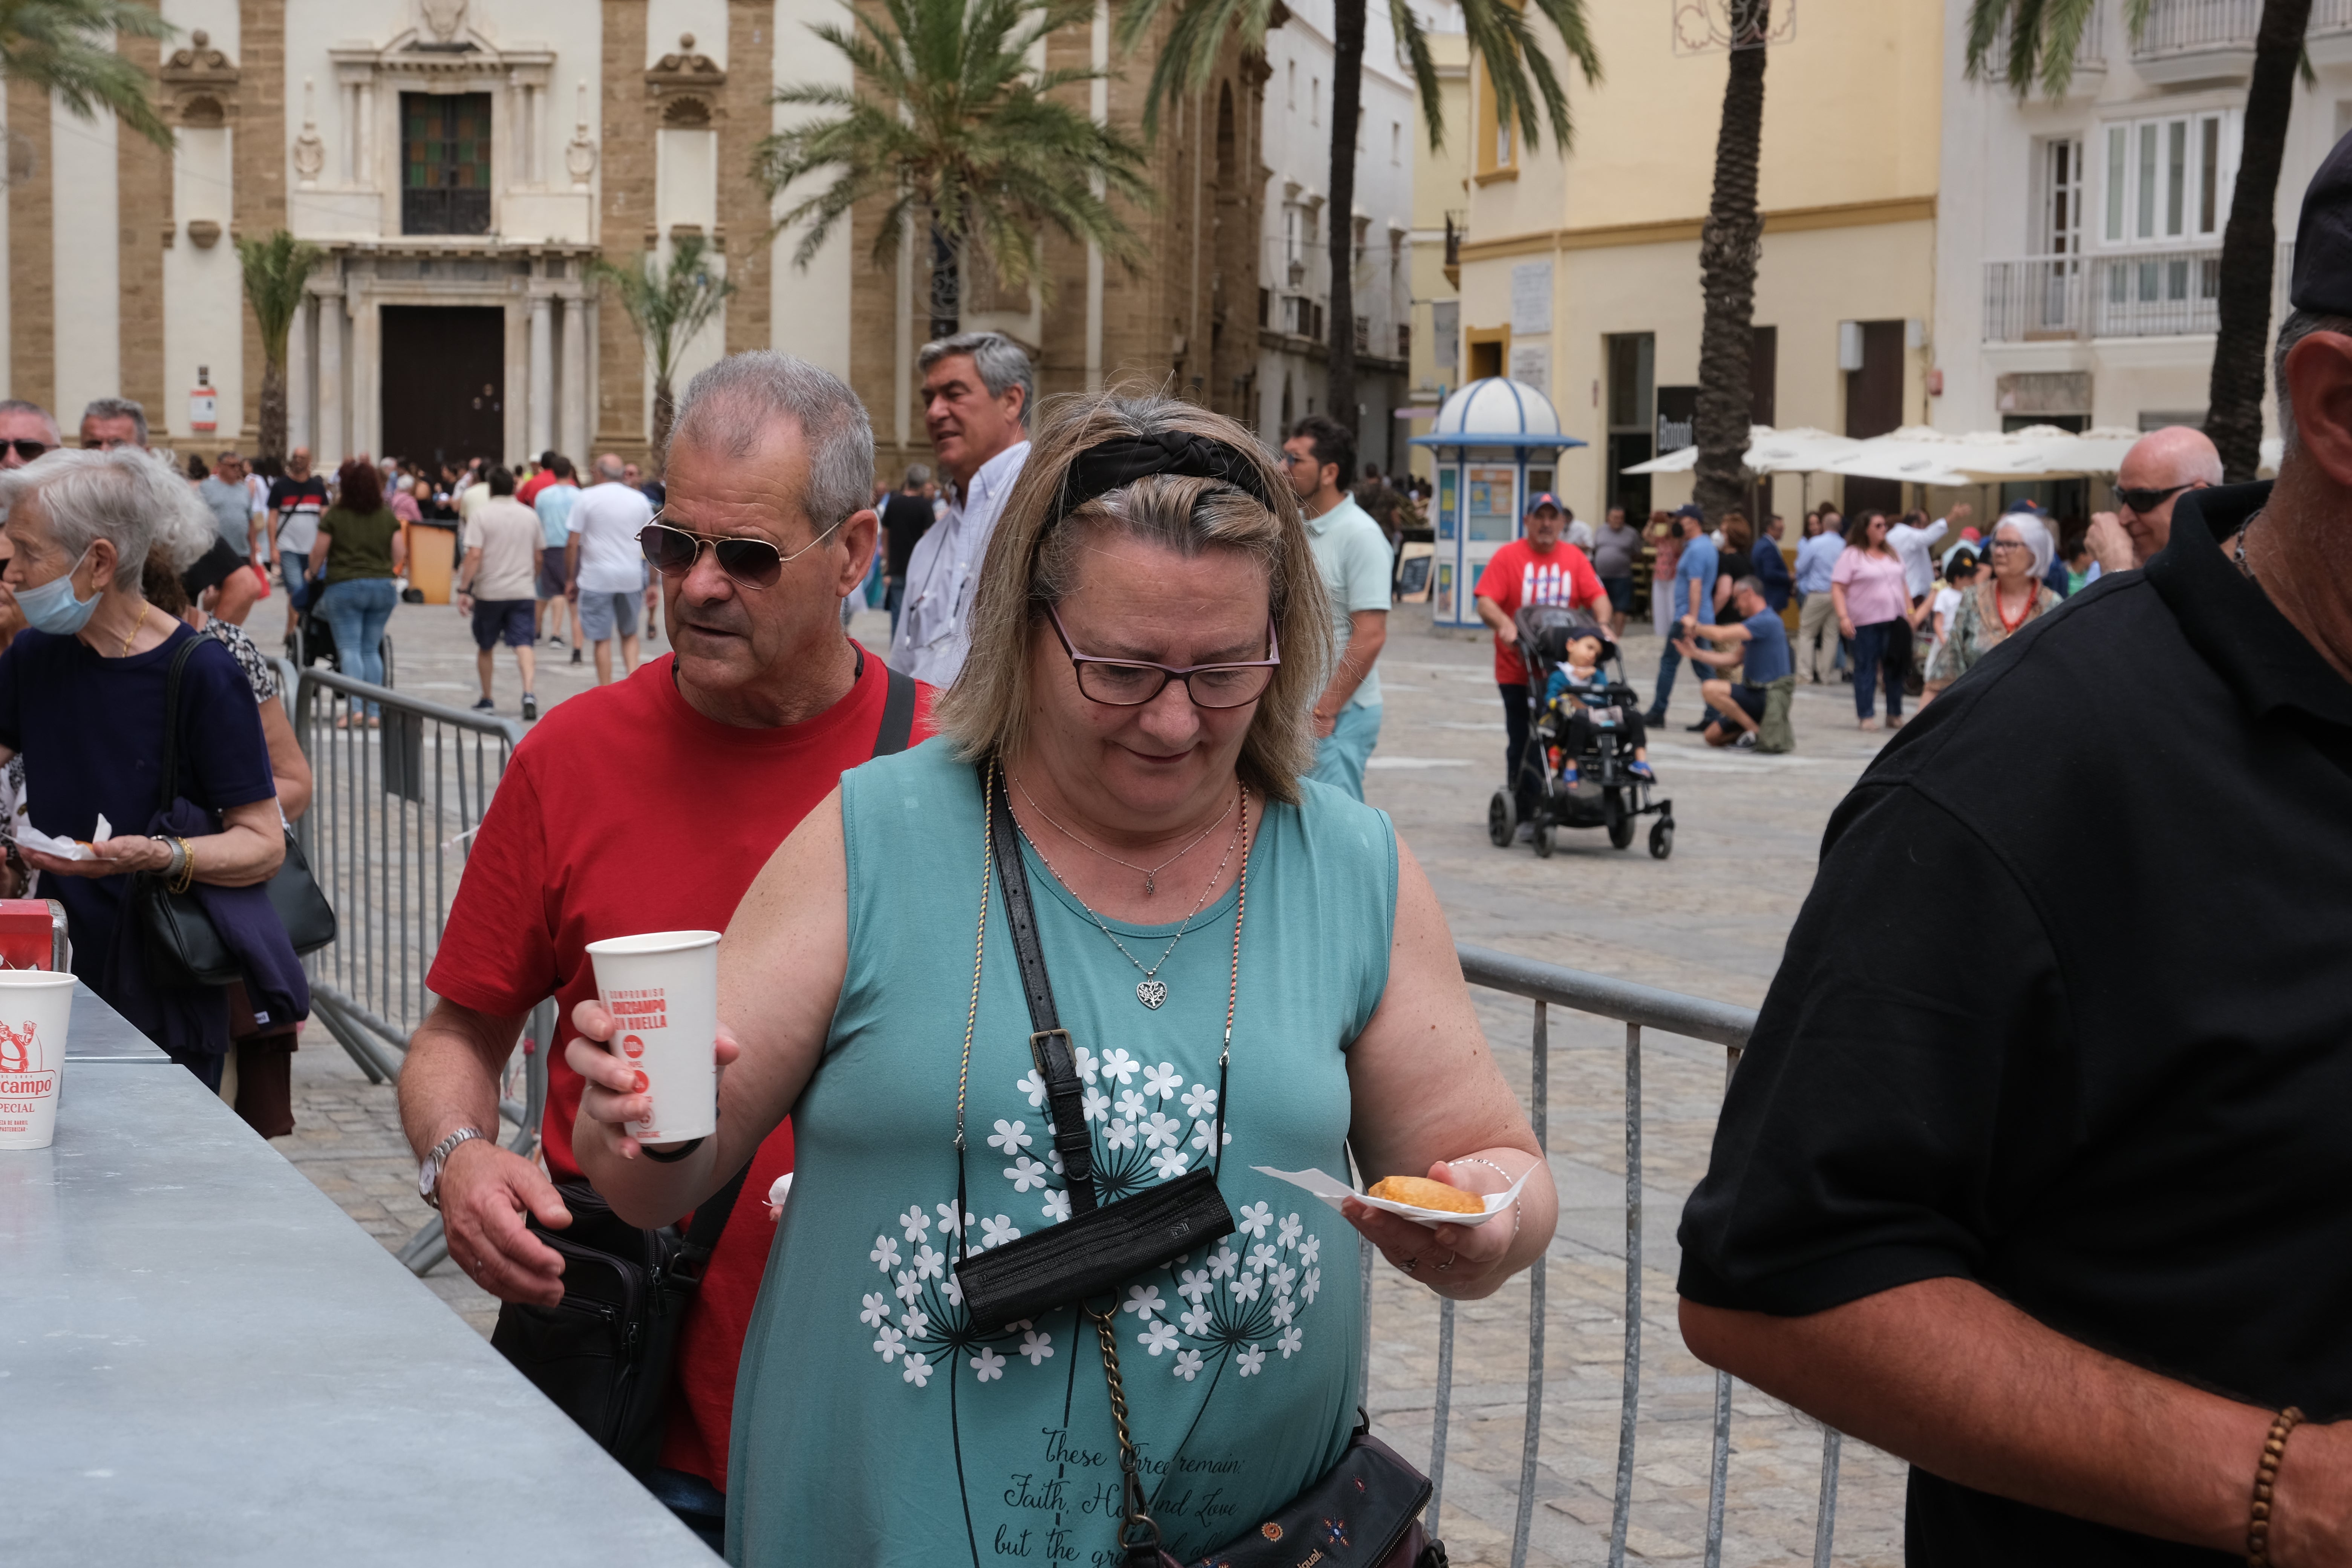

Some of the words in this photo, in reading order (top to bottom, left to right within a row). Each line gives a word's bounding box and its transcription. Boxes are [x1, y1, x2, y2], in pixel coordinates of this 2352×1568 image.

[0, 1079, 51, 1095] campo
[1042, 1427, 1107, 1467] These
[1180, 1453, 1245, 1475] remain:
[1004, 1474, 1071, 1514] Faith,
[1153, 1490, 1193, 1517] nd
[1194, 1488, 1239, 1527] Love
[994, 1524, 1032, 1557] but
[1046, 1527, 1080, 1561] the
